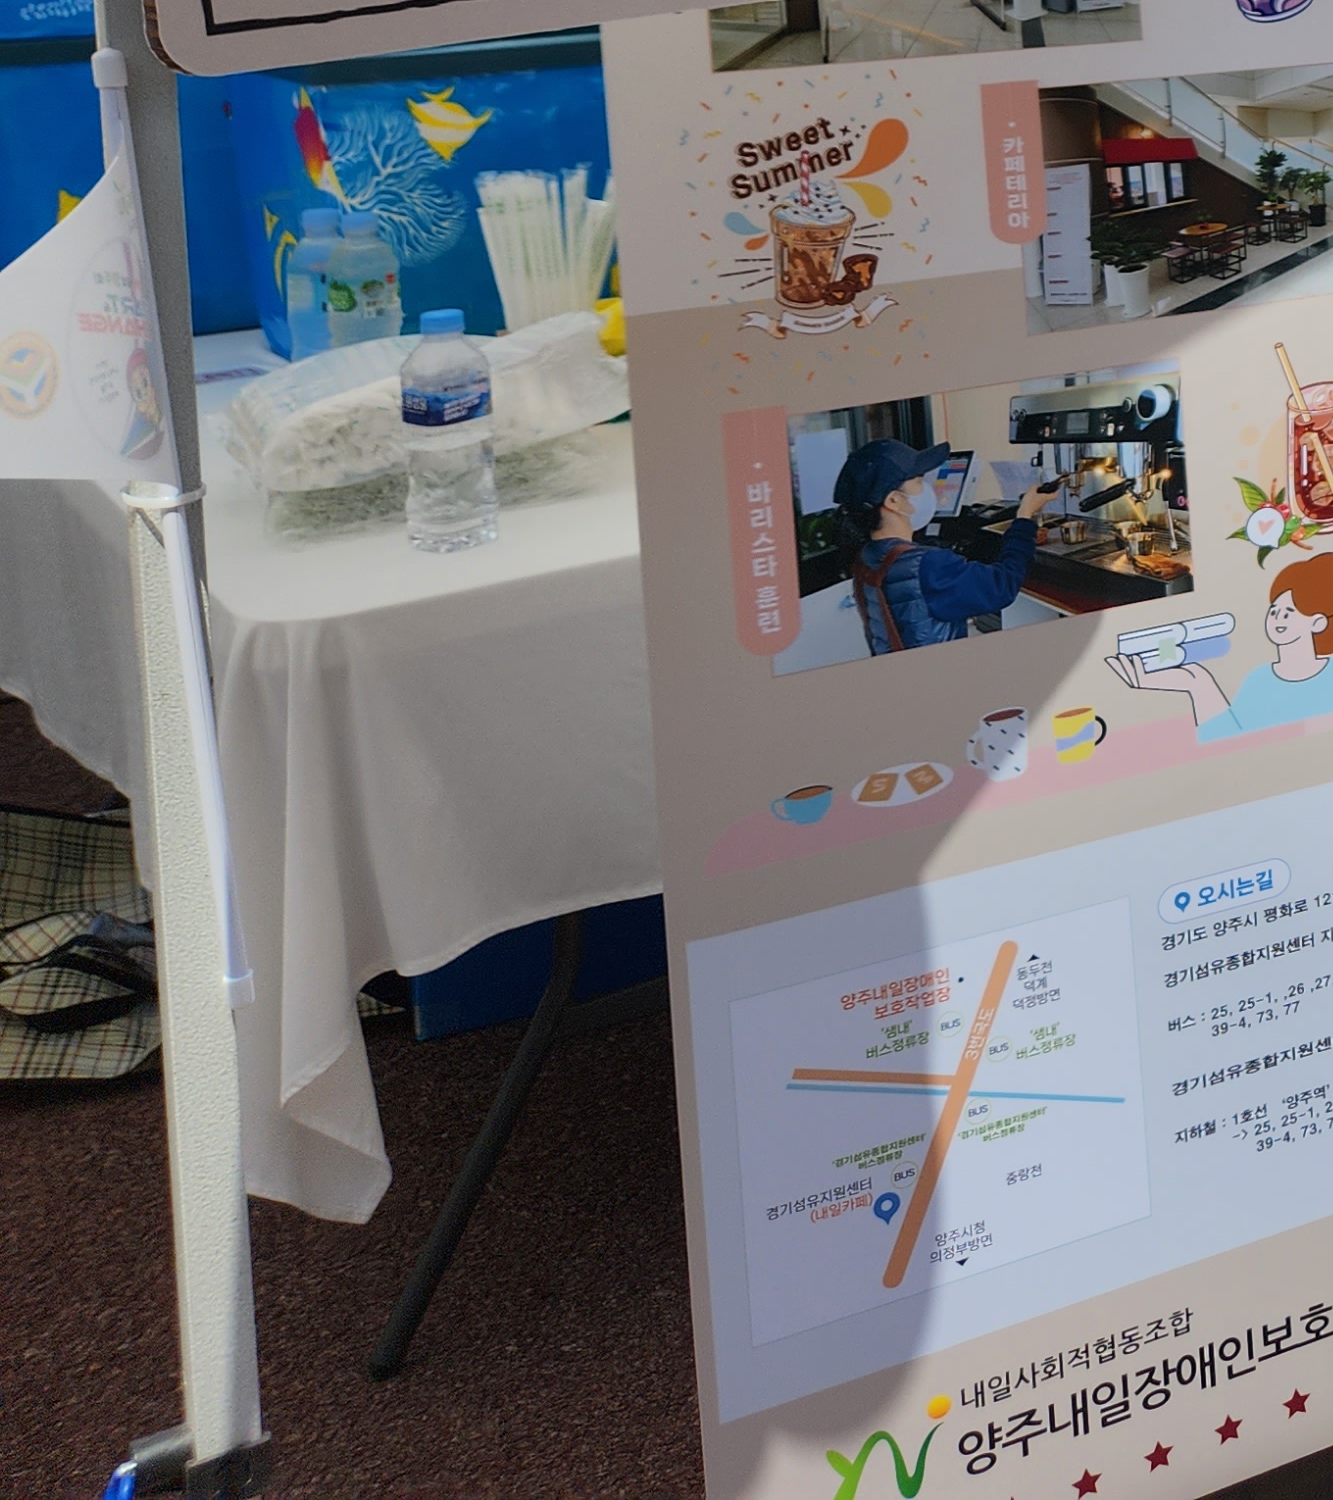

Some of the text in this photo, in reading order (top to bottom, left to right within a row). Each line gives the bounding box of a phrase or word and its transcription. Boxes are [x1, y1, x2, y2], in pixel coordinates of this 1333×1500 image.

[735, 117, 835, 168] Sweet
[729, 140, 854, 199] Summer
[1002, 136, 1030, 228] 카페테리아
[746, 480, 782, 635] 바리스타 훈련
[1197, 869, 1274, 907] 오시는길
[1161, 926, 1208, 951] 경기도
[1213, 912, 1258, 938] 양주시
[1264, 899, 1309, 924] 평화로
[1164, 932, 1316, 989] 경기섬유종합지원센터
[840, 967, 950, 1012] 양주내일장애인
[874, 987, 952, 1020] 보호작업장
[940, 1018, 961, 1032] BUS
[1168, 1015, 1196, 1032] 버스
[1211, 1005, 1234, 1022] 25,
[1238, 991, 1279, 1014] 25-1,
[1211, 1000, 1301, 1037] 39-4, 73, 77
[865, 1031, 930, 1060] 버스정류장
[988, 1042, 1010, 1056] BUS
[1015, 1033, 1076, 1061] 버스정류장
[968, 1104, 989, 1119] BUS
[1175, 1119, 1216, 1143] 지하철
[1232, 1103, 1268, 1125] 1호선
[1254, 1120, 1276, 1136] 25,
[1281, 1106, 1320, 1128] 25-1,
[1256, 1131, 1296, 1152] 39-4,
[1301, 1122, 1323, 1138] 73,
[893, 1167, 916, 1182] BUS
[766, 1177, 873, 1221] 경기섬유지원센터
[810, 1192, 874, 1224] (내일카페)
[929, 1233, 993, 1265] 의정부방면
[934, 1220, 987, 1247] 양주시청
[960, 1306, 1195, 1412] 내일사회적협동조합
